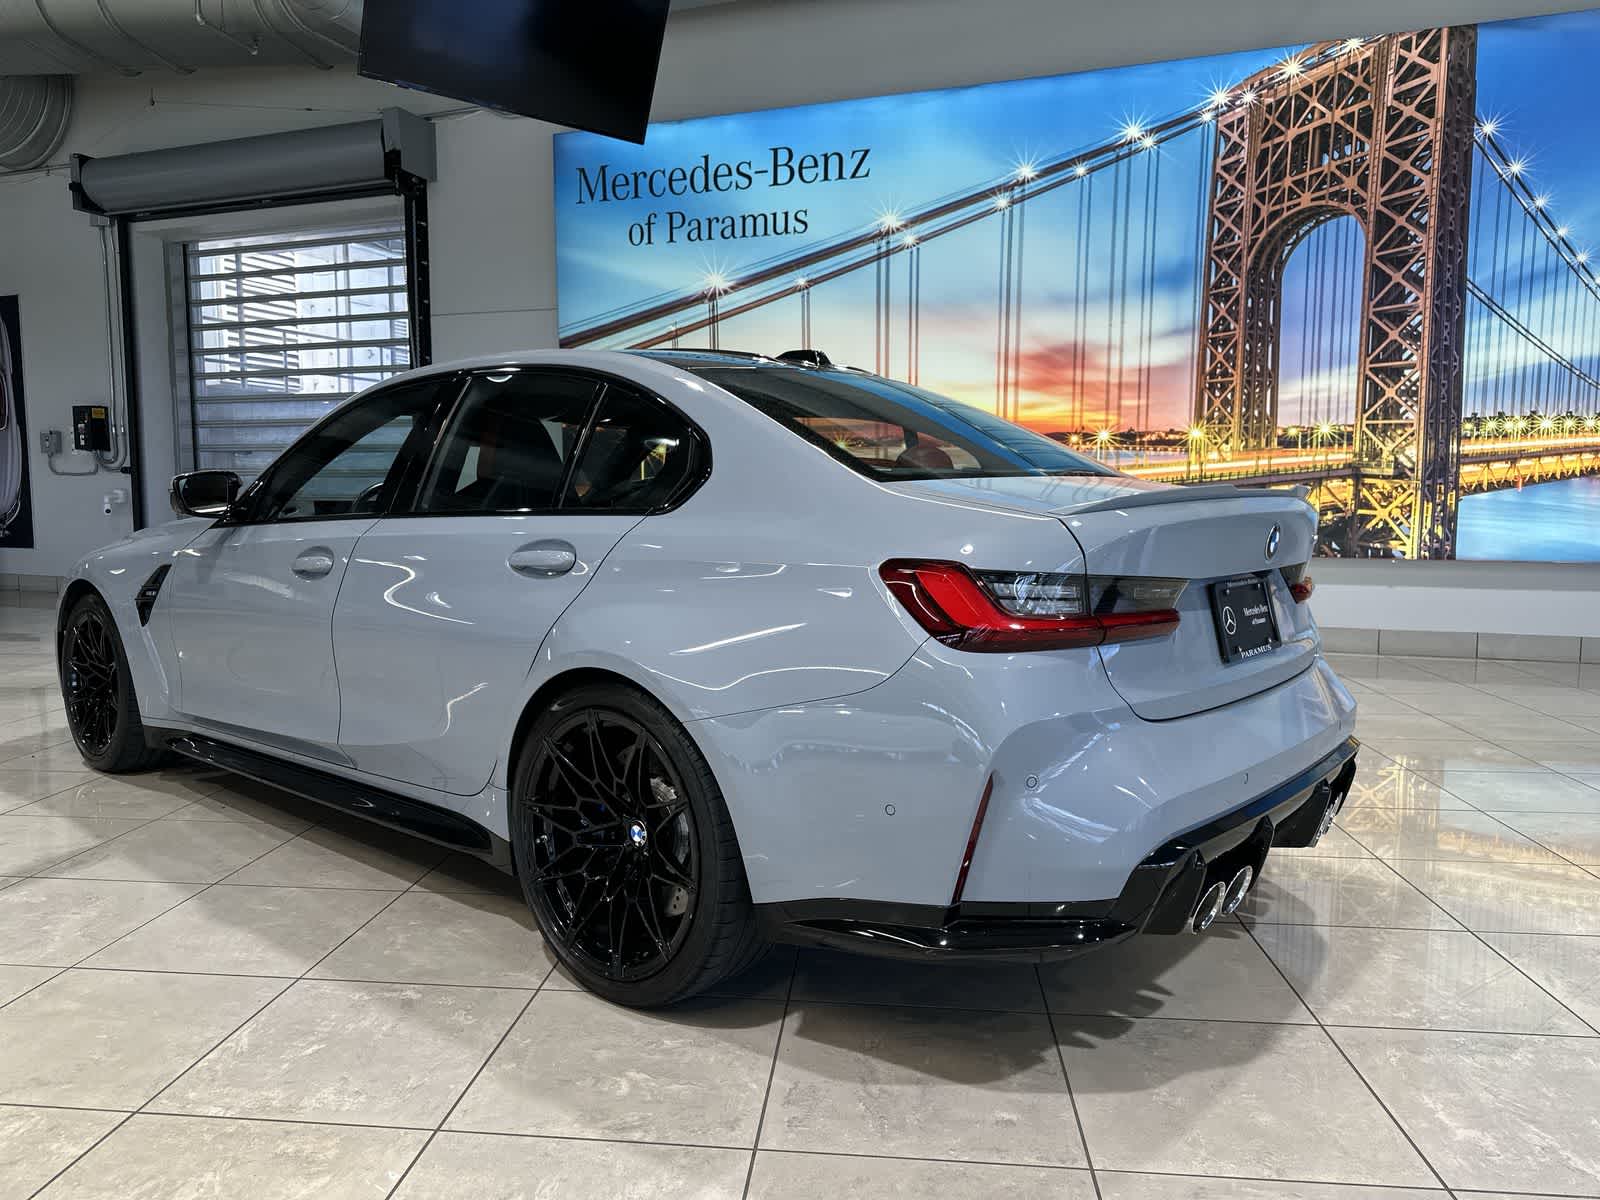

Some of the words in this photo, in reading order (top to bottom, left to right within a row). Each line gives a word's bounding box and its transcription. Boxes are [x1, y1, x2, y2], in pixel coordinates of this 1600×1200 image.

[575, 145, 871, 205] Mercedes-Benz
[628, 212, 657, 247] of
[666, 208, 809, 244] Paramus
[1240, 644, 1272, 659] PARAMUS
